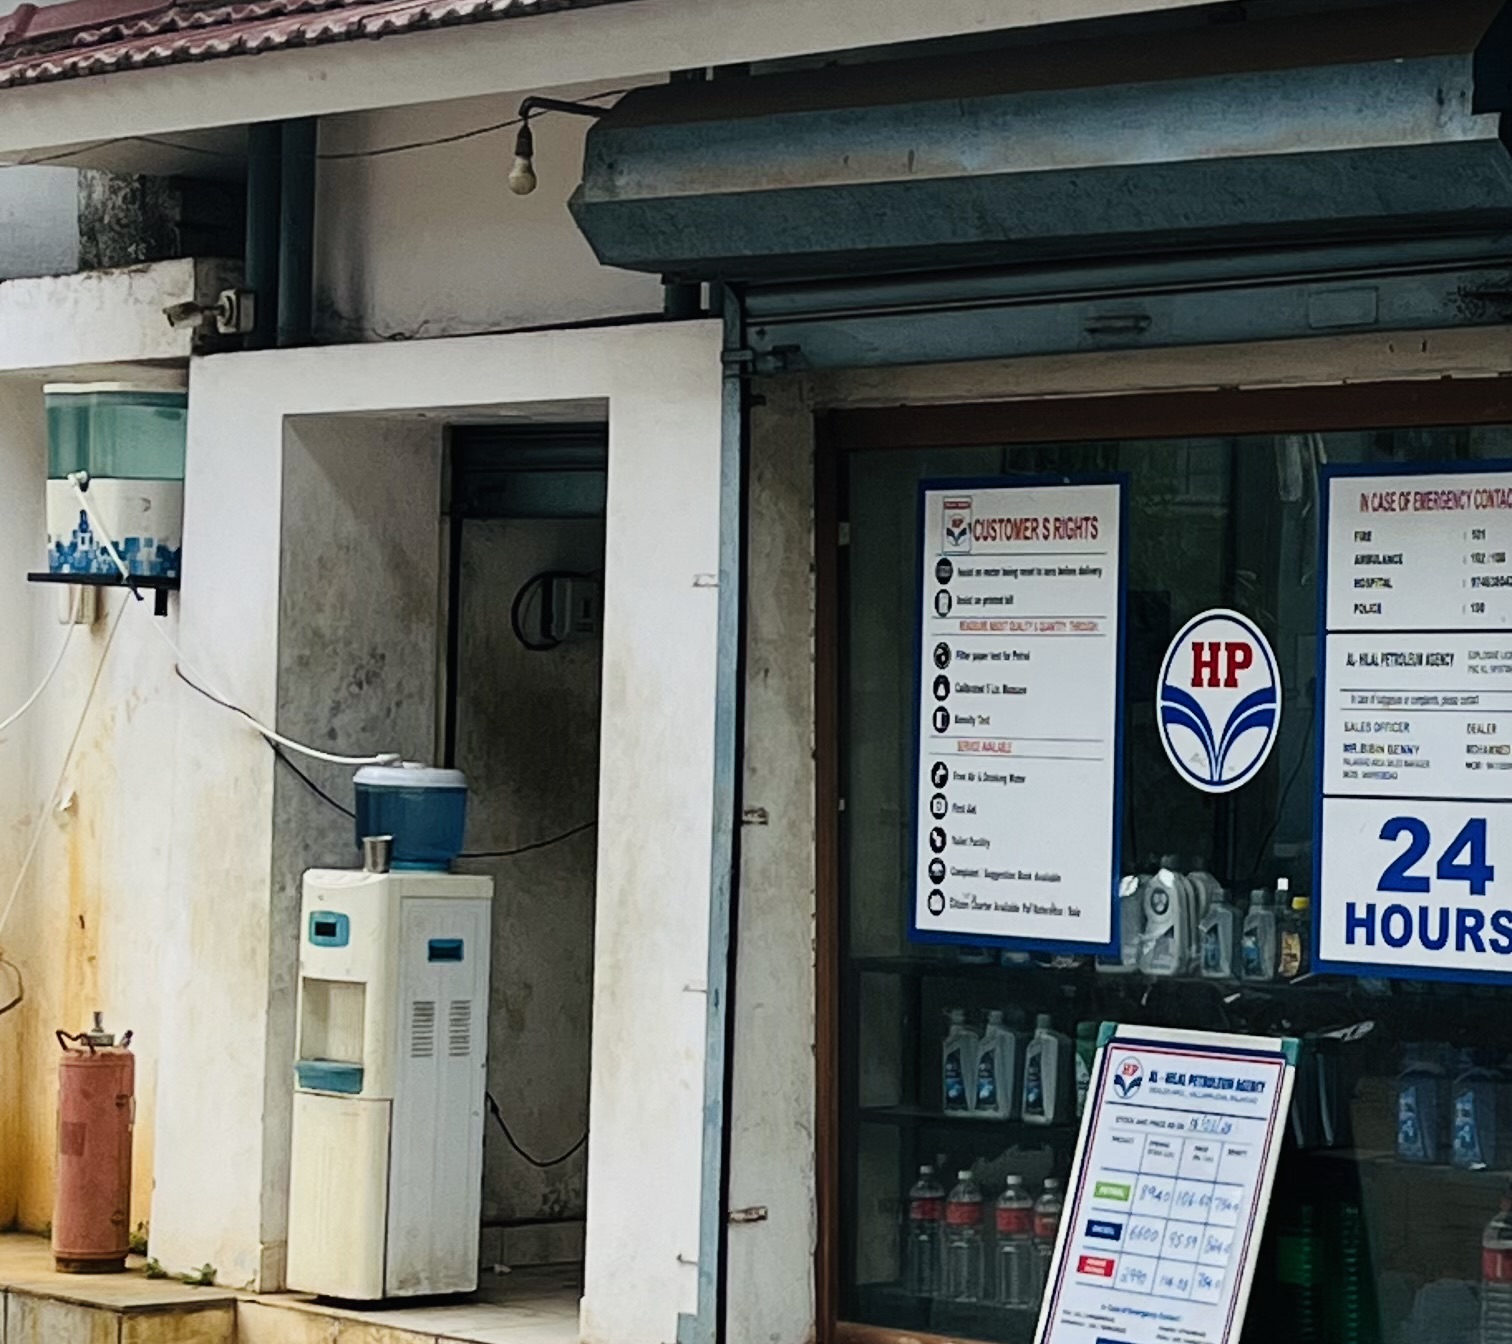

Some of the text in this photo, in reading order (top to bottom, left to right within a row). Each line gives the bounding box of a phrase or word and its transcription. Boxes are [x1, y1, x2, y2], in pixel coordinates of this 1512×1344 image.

[1371, 492, 1396, 512] CASE
[1398, 491, 1412, 512] OF
[1414, 489, 1472, 511] EMERGENCY
[1053, 516, 1099, 540] RIGHTS
[1191, 641, 1254, 688] HP
[1376, 816, 1495, 896] 24
